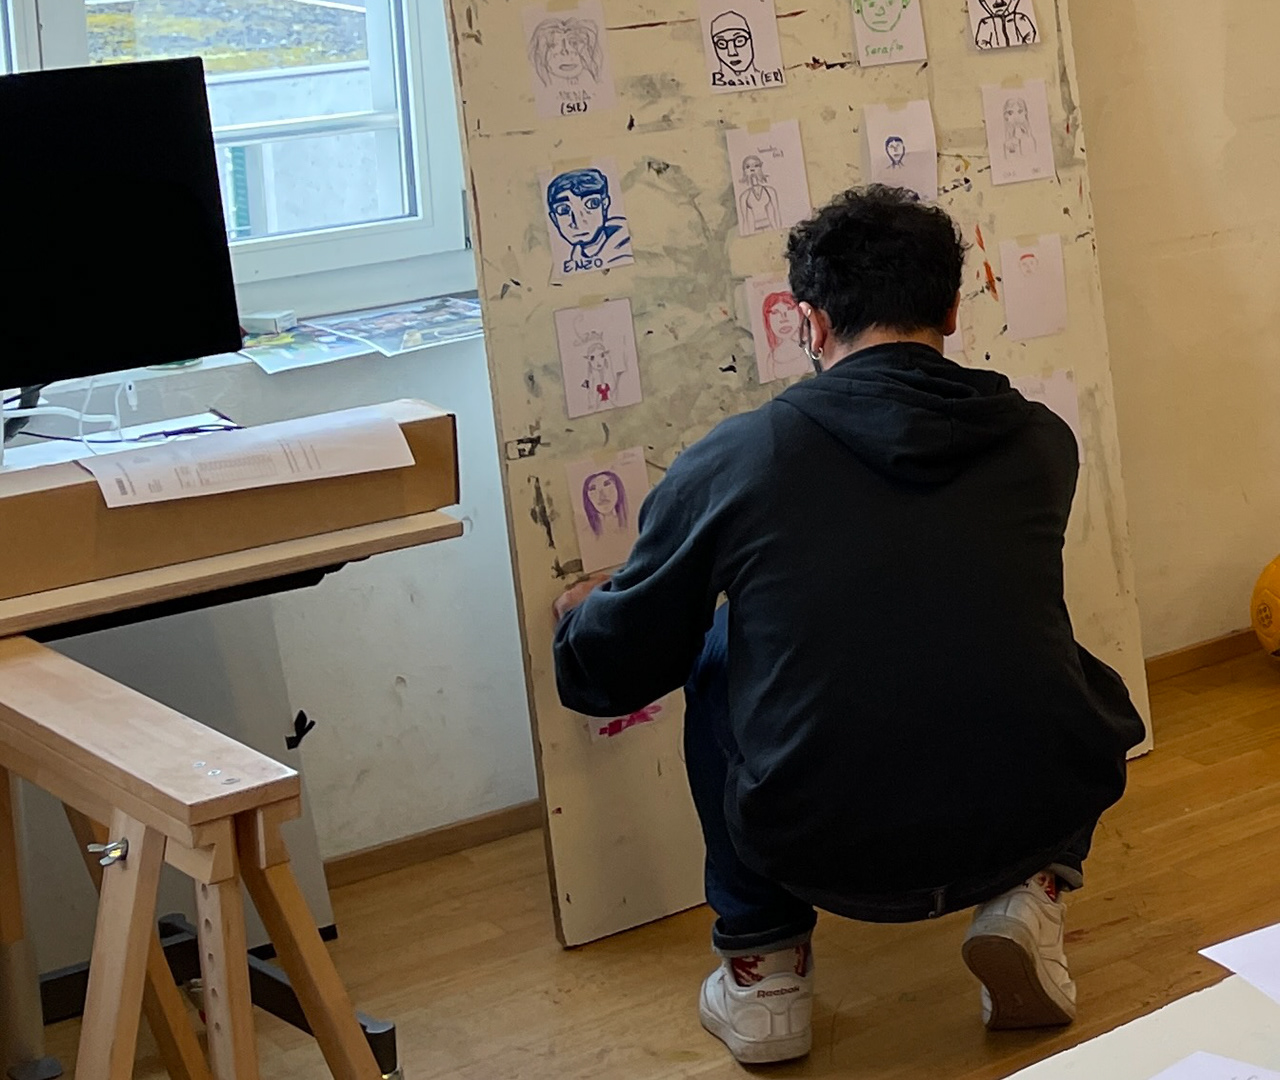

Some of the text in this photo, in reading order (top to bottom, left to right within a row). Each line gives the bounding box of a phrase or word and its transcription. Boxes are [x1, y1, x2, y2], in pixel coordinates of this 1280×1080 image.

[712, 72, 757, 86] Basil
[564, 258, 603, 273] ENZO
[757, 986, 800, 998] Reebok
